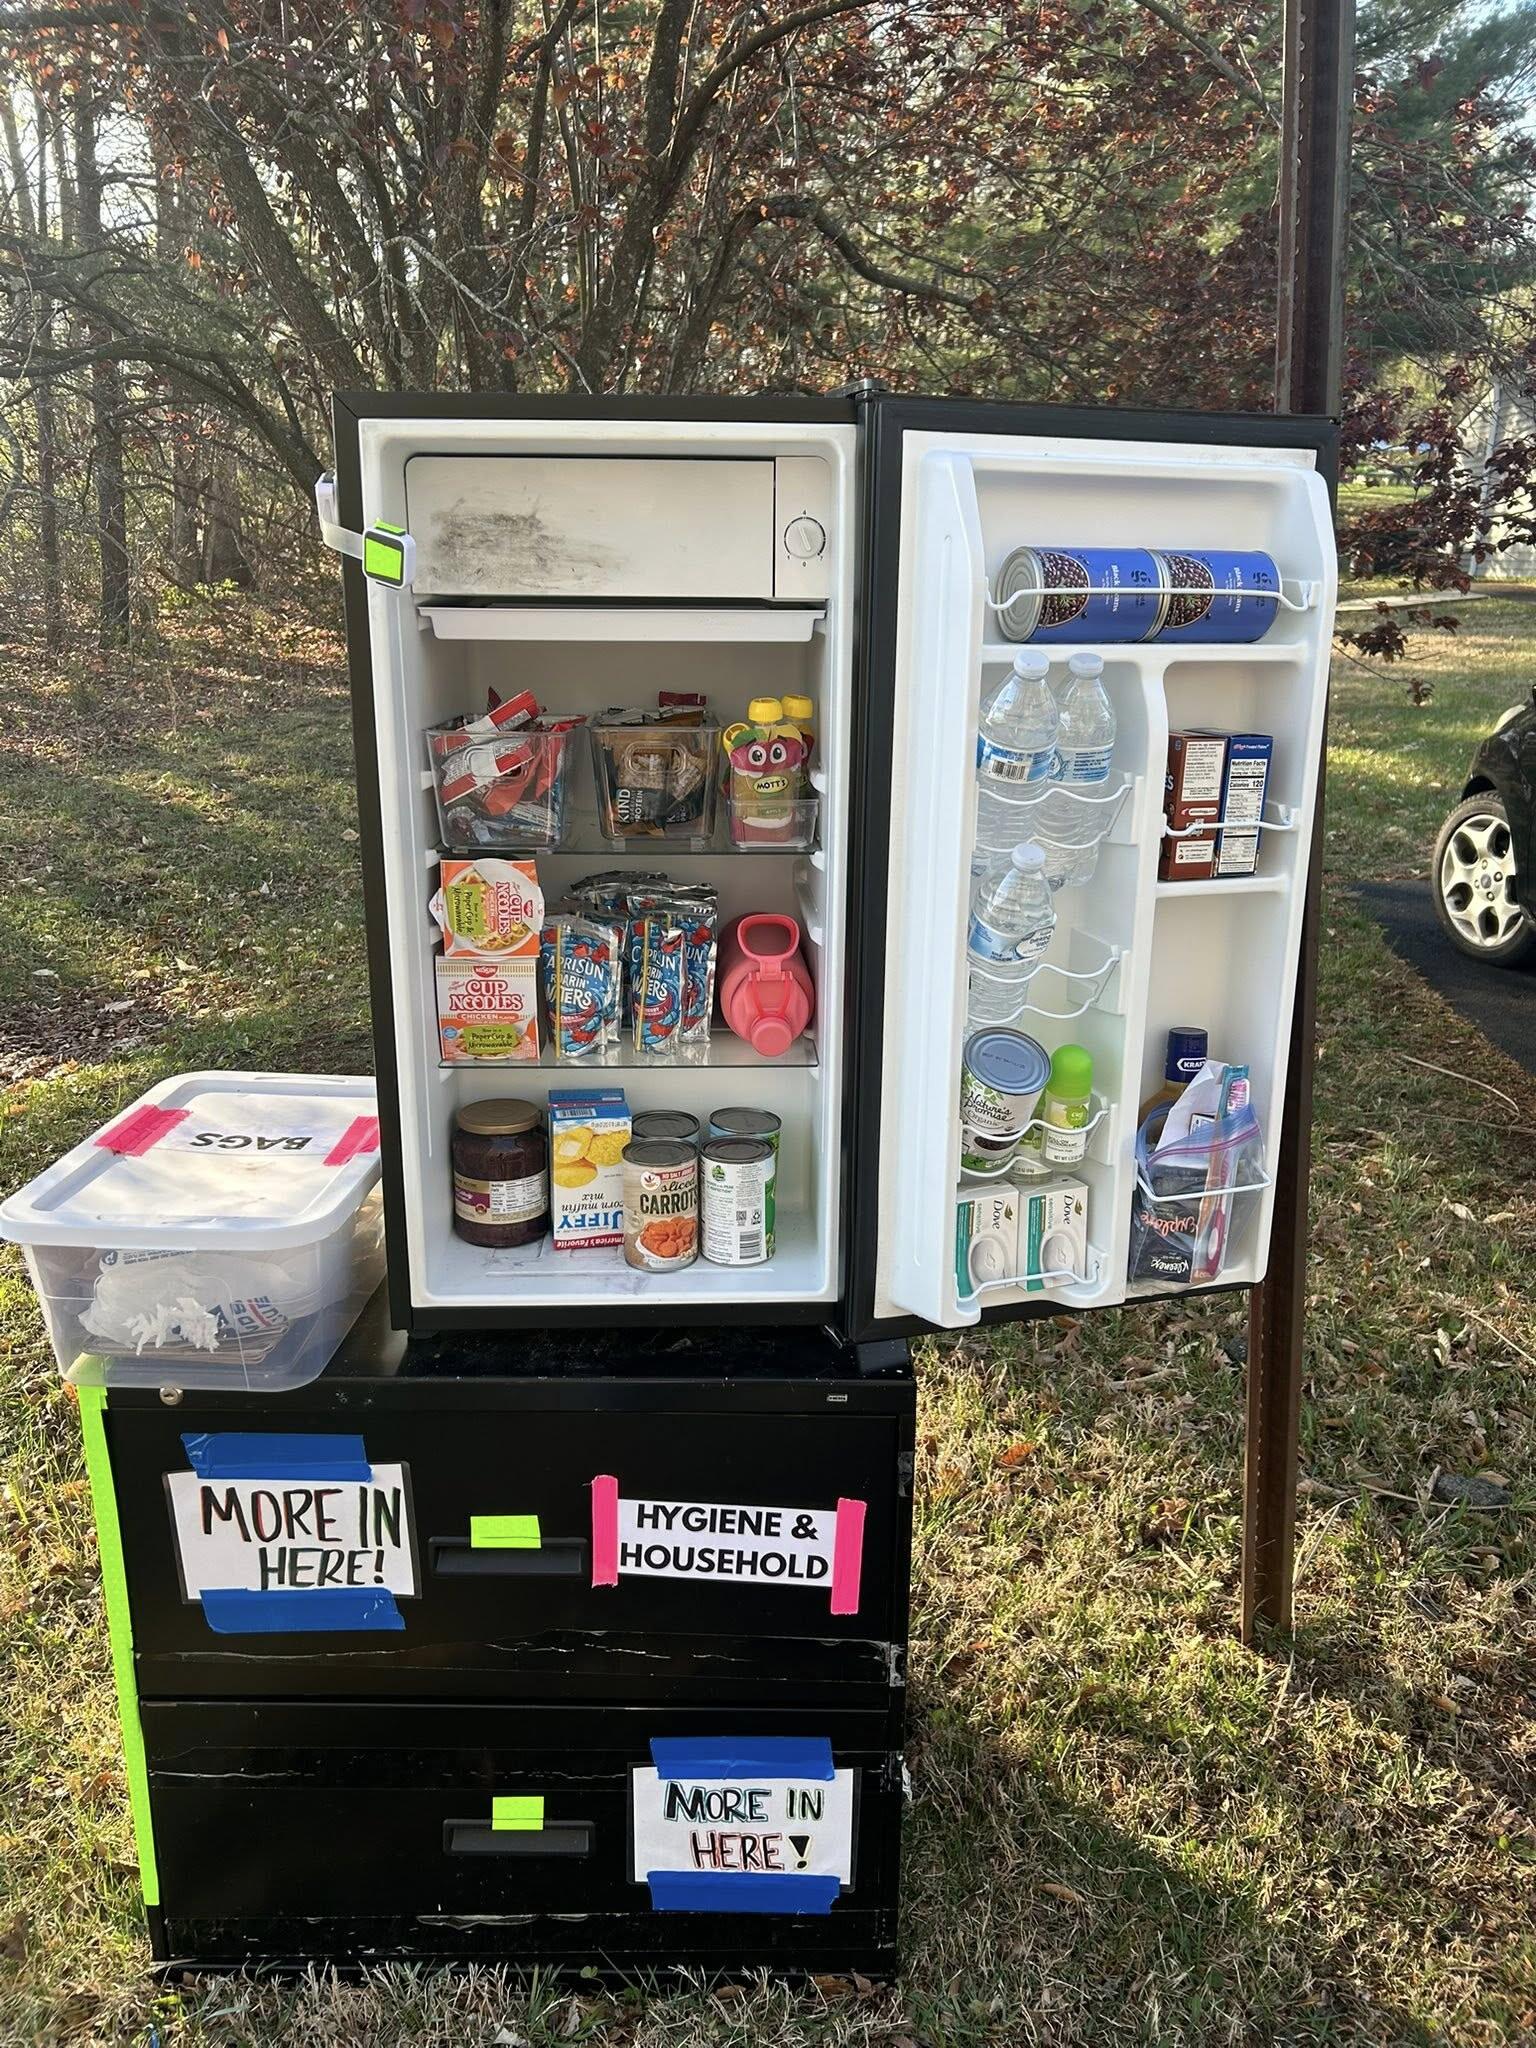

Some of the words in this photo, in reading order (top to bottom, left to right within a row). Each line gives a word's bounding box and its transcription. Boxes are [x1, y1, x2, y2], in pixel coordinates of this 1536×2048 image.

[1252, 780, 1264, 788] 120
[617, 788, 631, 824] KIND
[462, 891, 474, 911] Paper
[496, 881, 512, 935] NOODLES
[509, 894, 523, 924] CUP
[465, 979, 508, 996] CUP
[547, 983, 593, 1010] WTERS
[449, 993, 524, 1012] NOODLES
[1183, 1060, 1206, 1069] KRAF
[963, 1090, 1013, 1115] Nature's
[189, 1132, 314, 1150] BAGS
[661, 1174, 696, 1192] sliced
[562, 1200, 598, 1212] muffin
[582, 1192, 604, 1201] mix
[558, 1210, 624, 1230] JIFFY
[992, 1199, 1005, 1230] Dove
[1063, 1194, 1074, 1225] Dove
[1140, 1210, 1197, 1237] Explore
[556, 1238, 590, 1249] Favorite
[590, 1236, 624, 1247] merica's
[1151, 1259, 1189, 1274] Kleenex
[200, 1485, 344, 1543] MORE
[358, 1485, 401, 1549] IN
[637, 1503, 782, 1537] HYGIENE
[791, 1513, 819, 1540] &
[258, 1546, 387, 1591] HERE!
[620, 1542, 829, 1579] HOUSEHOLD
[664, 1780, 772, 1823] MORE
[786, 1787, 825, 1821] IN
[690, 1829, 813, 1871] HERE!
